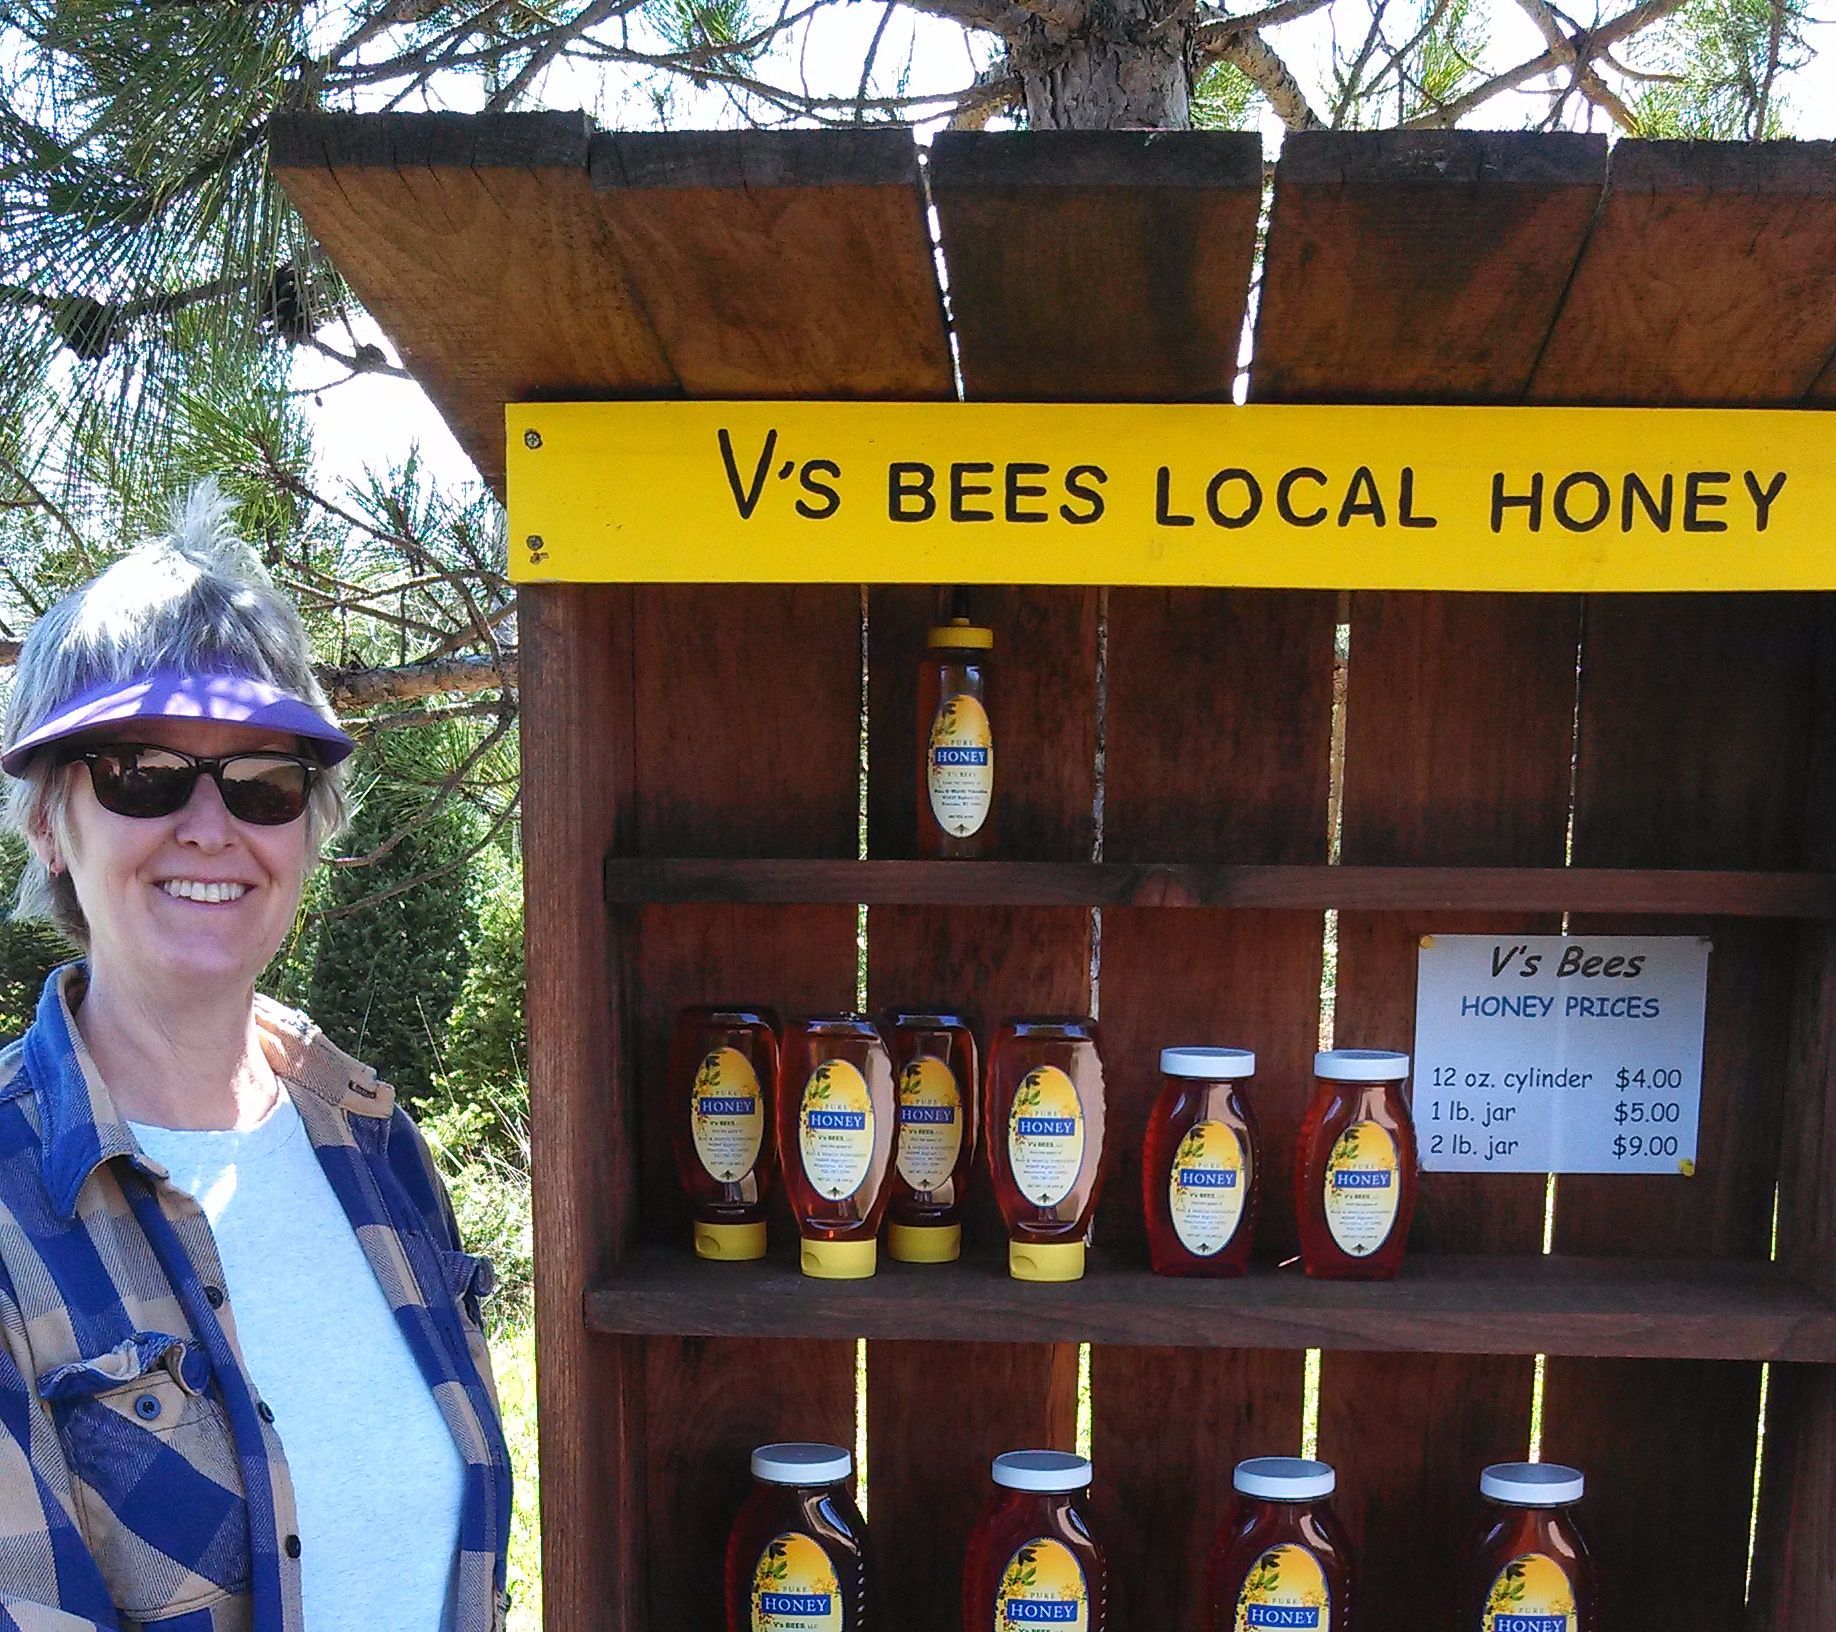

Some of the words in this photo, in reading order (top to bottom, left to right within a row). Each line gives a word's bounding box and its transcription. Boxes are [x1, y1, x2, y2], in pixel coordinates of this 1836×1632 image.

[718, 427, 841, 521] V'S
[889, 462, 1106, 525] BEES
[1155, 466, 1438, 529] LOCAL
[1490, 471, 1787, 534] HONEY
[937, 751, 985, 762] HONEY
[1491, 945, 1542, 978] V's
[1556, 945, 1646, 978] Bees
[1461, 995, 1554, 1018] HONEY
[1566, 995, 1660, 1018] PRICES
[1432, 1067, 1456, 1088] 12
[1465, 1071, 1495, 1089] oz.
[1504, 1067, 1593, 1095] cylinder
[1615, 1066, 1682, 1092] $4.00
[702, 1101, 752, 1112] HONEY
[1431, 1101, 1440, 1121] 1
[1450, 1101, 1475, 1122] lb.
[1482, 1103, 1516, 1127] jar
[1614, 1100, 1680, 1126] $5.00
[811, 1114, 862, 1127] HONEY
[902, 1109, 951, 1121] HONEY
[1020, 1122, 1072, 1133] HONEY
[1430, 1134, 1443, 1155] 2
[1452, 1134, 1477, 1155] lb.
[1485, 1137, 1519, 1160] jar
[1612, 1134, 1678, 1159] $9.00
[1183, 1172, 1234, 1184] HONEY
[1337, 1174, 1389, 1185] HONEY
[765, 1598, 828, 1612] HONEY
[1010, 1604, 1074, 1618] HONEY
[1251, 1608, 1316, 1624] HONEY
[1498, 1619, 1563, 1632] HONEY
